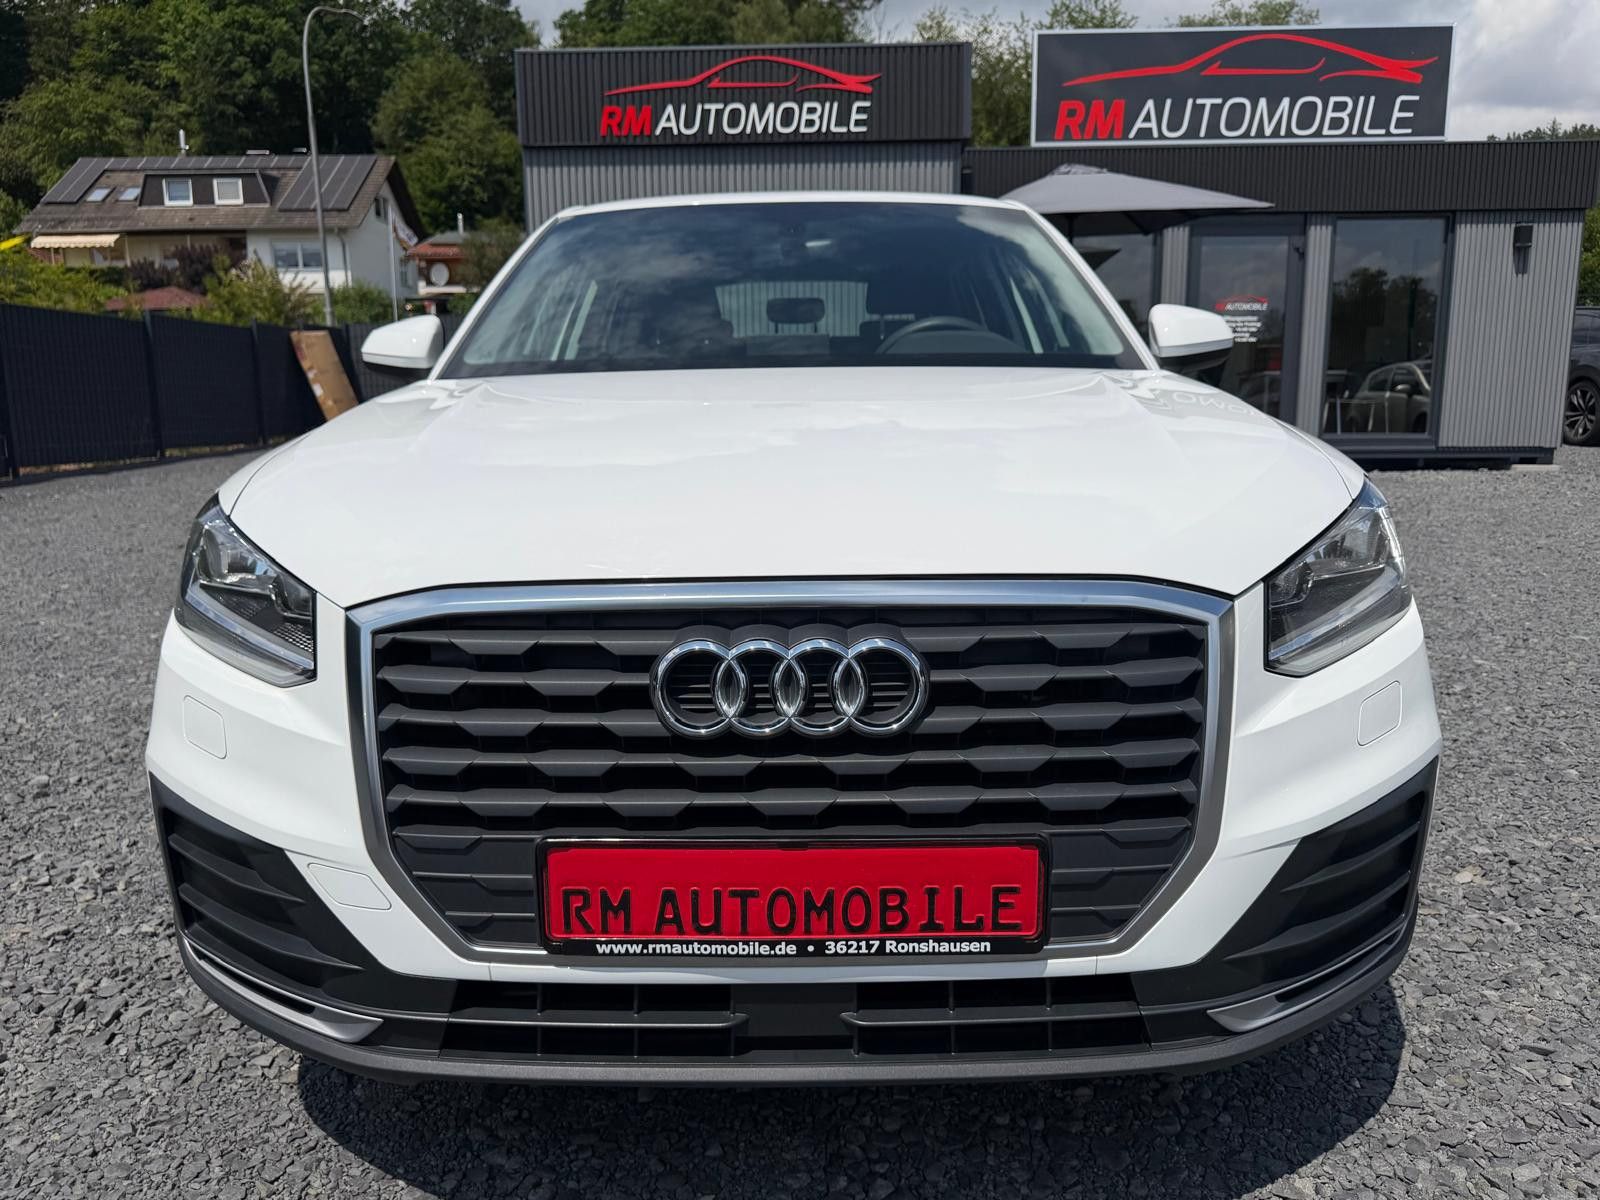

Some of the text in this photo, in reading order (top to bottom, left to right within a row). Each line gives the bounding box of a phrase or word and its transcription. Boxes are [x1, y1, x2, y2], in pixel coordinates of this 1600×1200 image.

[600, 100, 872, 137] RM AUTOMOBILE
[1054, 95, 1420, 141] RM AUTOMOBILE
[561, 885, 1023, 935] RM AUTOMOBILE
[595, 939, 991, 955] www.rmautomobile.de 36217 Ronshausen
